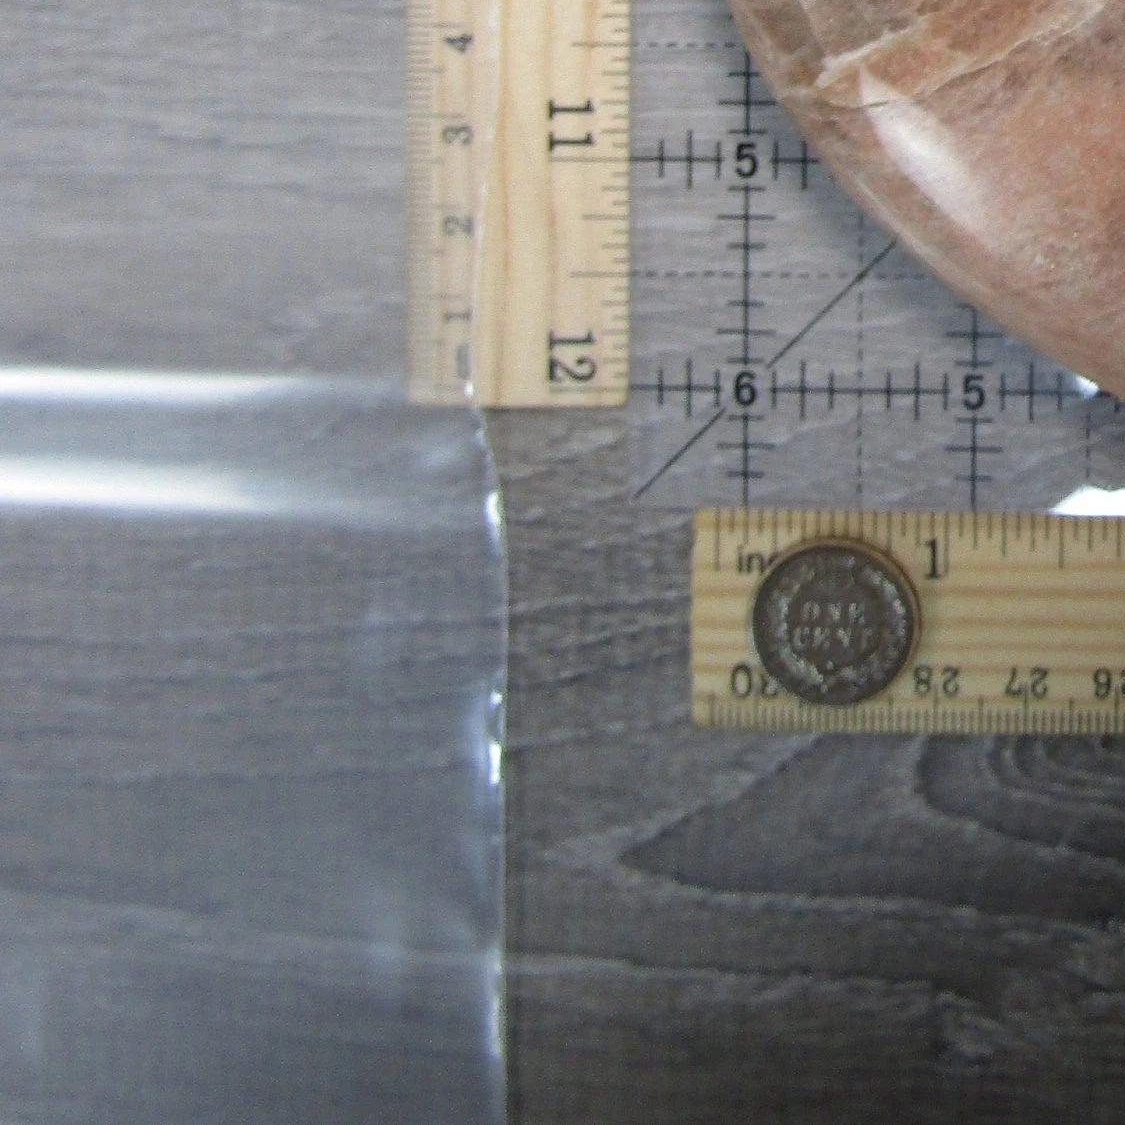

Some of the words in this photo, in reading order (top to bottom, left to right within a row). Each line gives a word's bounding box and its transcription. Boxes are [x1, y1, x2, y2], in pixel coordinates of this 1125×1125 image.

[444, 33, 474, 54] 4
[441, 126, 473, 146] 3
[549, 99, 594, 152] 11
[735, 143, 758, 177] 5
[442, 215, 473, 235] 2
[443, 308, 472, 322] 1
[548, 330, 597, 382] 12
[734, 371, 757, 407] 6
[963, 375, 985, 410] 5
[924, 538, 940, 579] 1
[914, 664, 960, 697] 28
[1004, 666, 1048, 700] 27
